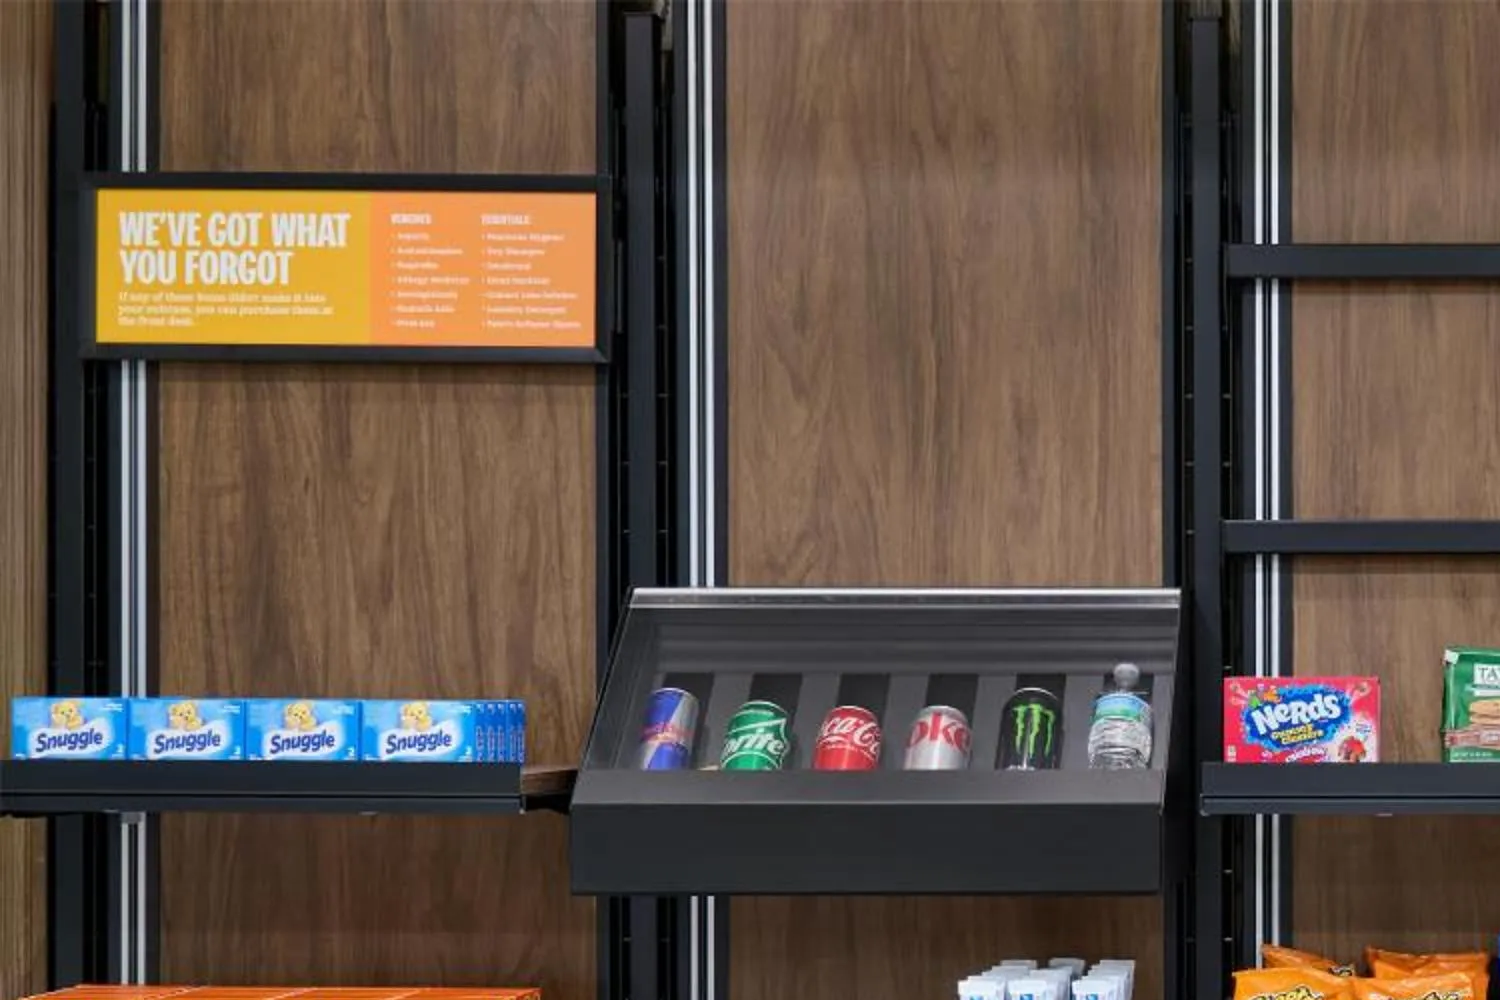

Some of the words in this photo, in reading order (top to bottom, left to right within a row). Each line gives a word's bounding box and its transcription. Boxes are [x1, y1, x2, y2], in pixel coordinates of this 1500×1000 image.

[118, 212, 201, 247] WE'VE
[207, 212, 263, 247] GOT
[271, 213, 351, 247] WHAT
[119, 251, 176, 285] YOU
[184, 251, 294, 285] FORGOT
[35, 728, 103, 752] Snuggle
[154, 729, 221, 754] Snuggle
[270, 730, 335, 753] Snuggle
[386, 729, 452, 754] Snuggle
